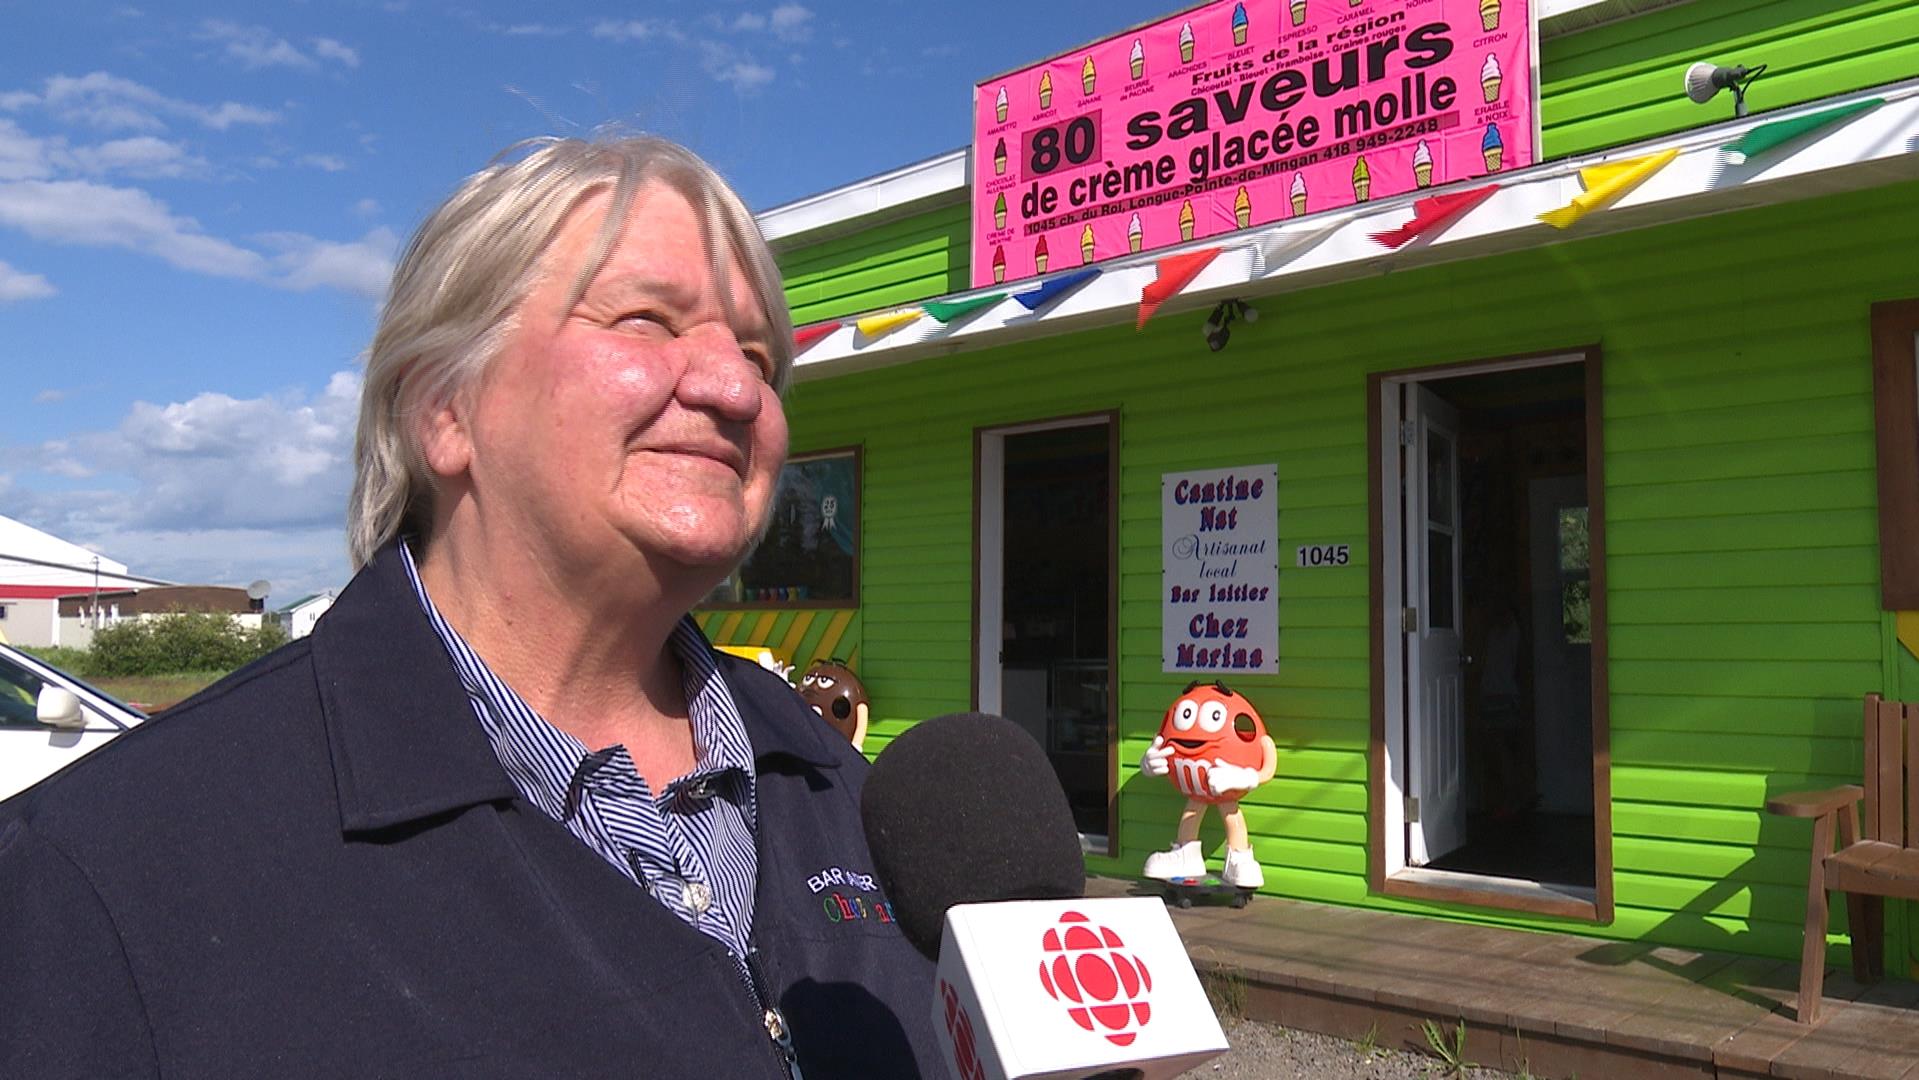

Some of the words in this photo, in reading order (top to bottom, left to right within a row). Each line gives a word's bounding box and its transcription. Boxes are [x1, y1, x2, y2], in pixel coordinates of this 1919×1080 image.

[1337, 7, 1375, 24] CARAMEL
[1278, 25, 1318, 44] ESPRESSO
[1473, 32, 1508, 48] CITRON
[1192, 59, 1254, 85] Fruits
[1262, 48, 1290, 63] de
[1297, 39, 1318, 53] la
[1327, 11, 1405, 44] région
[1227, 46, 1255, 60] BLEUET
[1240, 65, 1269, 81] Bleuet
[1276, 50, 1324, 70] Framboise
[1332, 35, 1370, 53] Graines
[1371, 25, 1406, 40] rouges
[1168, 61, 1207, 79] ARACHIDES
[1126, 22, 1454, 150] saveurs
[1032, 109, 1057, 121] ABRICOT
[1021, 181, 1058, 219] de
[1069, 155, 1176, 207] crème
[1189, 111, 1320, 184] glacée
[1334, 71, 1457, 139] molle
[1031, 116, 1095, 174] 80
[1028, 218, 1056, 234] 1045
[1082, 208, 1097, 221] du
[1323, 143, 1350, 163] 418
[1356, 118, 1438, 150] 949-2248
[1174, 475, 1264, 505] Cantine
[1199, 506, 1238, 532] Nat
[1172, 534, 1266, 560] Artisanal
[1299, 546, 1349, 566] 1045
[1199, 560, 1238, 579] local
[1170, 585, 1200, 603] Bar
[1208, 583, 1269, 602] laitier
[1189, 612, 1249, 639] Chez
[1175, 643, 1264, 669] Marina
[807, 867, 846, 893] BAR
